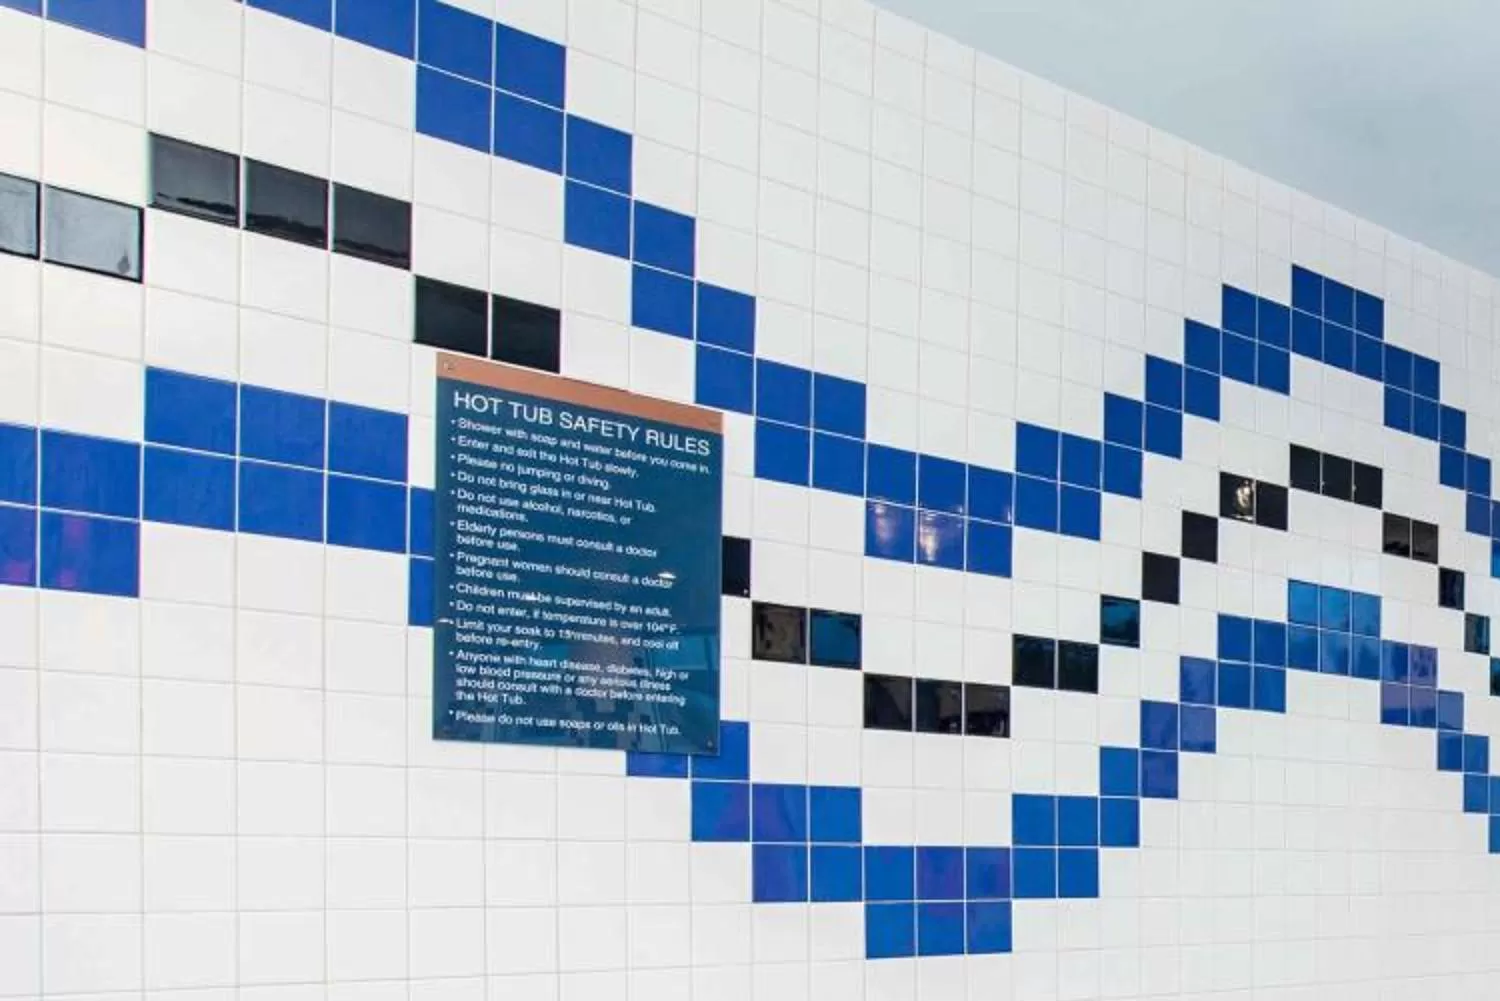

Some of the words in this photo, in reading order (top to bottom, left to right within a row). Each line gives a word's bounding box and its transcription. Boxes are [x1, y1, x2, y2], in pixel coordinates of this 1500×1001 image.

[453, 390, 503, 415] HOT
[508, 401, 553, 425] TUB
[559, 411, 640, 441] SAFETY
[645, 429, 710, 456] RULES
[457, 417, 502, 435] Shower
[505, 428, 529, 440] with
[530, 433, 558, 446] soap
[559, 439, 581, 450] and
[583, 443, 612, 455] water
[614, 448, 647, 462] before
[650, 456, 669, 467] you
[670, 459, 697, 471] come
[457, 435, 489, 450] Enter
[492, 443, 515, 454] and
[516, 447, 537, 458] exit
[539, 450, 557, 462] the
[560, 455, 579, 466] Hot
[582, 458, 602, 470] Tub
[457, 453, 498, 468] Please
[500, 462, 515, 473] no
[517, 465, 561, 482] jumping
[563, 473, 575, 483] or
[457, 471, 474, 483] Do
[477, 476, 497, 487] not
[499, 478, 527, 494] bring
[529, 484, 559, 497] glass
[561, 489, 572, 499] in
[574, 491, 585, 501] or
[587, 494, 612, 505] near
[614, 496, 633, 509] Hot
[457, 488, 475, 500] Do
[477, 493, 497, 503] not
[499, 498, 520, 507] use
[620, 516, 631, 525] or
[456, 534, 494, 548] before
[457, 520, 497, 537] Elderly
[499, 527, 544, 542] persons
[547, 534, 574, 545] must
[575, 539, 614, 552] consult
[616, 545, 623, 553] a
[625, 545, 657, 558] doctor
[455, 565, 493, 579] before
[457, 551, 509, 567] Pregnant
[512, 560, 553, 573] women
[554, 564, 590, 579] should
[592, 571, 630, 583] consult
[632, 576, 639, 585] a
[641, 577, 673, 589] doctor
[456, 582, 505, 597] Children
[507, 590, 536, 601] must
[537, 592, 552, 602] be
[555, 595, 613, 611] supervised
[614, 601, 627, 614] by
[629, 605, 642, 614] an
[456, 600, 473, 612] Do
[476, 604, 495, 614] not
[542, 610, 606, 627] temperature
[609, 618, 618, 628] is
[620, 620, 643, 630] over
[456, 618, 485, 630] Limit
[487, 622, 512, 633] your
[515, 625, 541, 636] soak
[543, 628, 555, 638] to
[621, 636, 640, 646] and
[643, 638, 664, 648] cool
[666, 640, 679, 650] off
[456, 632, 493, 645] before
[455, 663, 476, 674] low
[479, 665, 511, 677] blood
[513, 669, 562, 681] pressure
[563, 674, 575, 682] or
[578, 675, 597, 687] any
[600, 677, 637, 688] serious
[640, 680, 671, 691] illness
[456, 649, 500, 663] Anyone
[503, 653, 527, 665] with
[529, 656, 557, 668] heart
[655, 668, 677, 680] high
[678, 671, 689, 680] or
[455, 691, 474, 701] the
[477, 692, 498, 702] Hot
[456, 677, 495, 689] should
[497, 681, 537, 693] consult
[540, 684, 562, 694] with
[564, 687, 572, 695] a
[574, 687, 607, 699] doctor
[609, 689, 643, 701] before
[645, 692, 686, 707] entering
[455, 710, 495, 723] Please
[498, 713, 512, 725] do
[515, 716, 533, 726] not
[536, 719, 556, 727] use
[559, 720, 590, 730] soaps
[607, 721, 625, 731] oils
[627, 723, 637, 732] in
[639, 723, 657, 734] Hot
